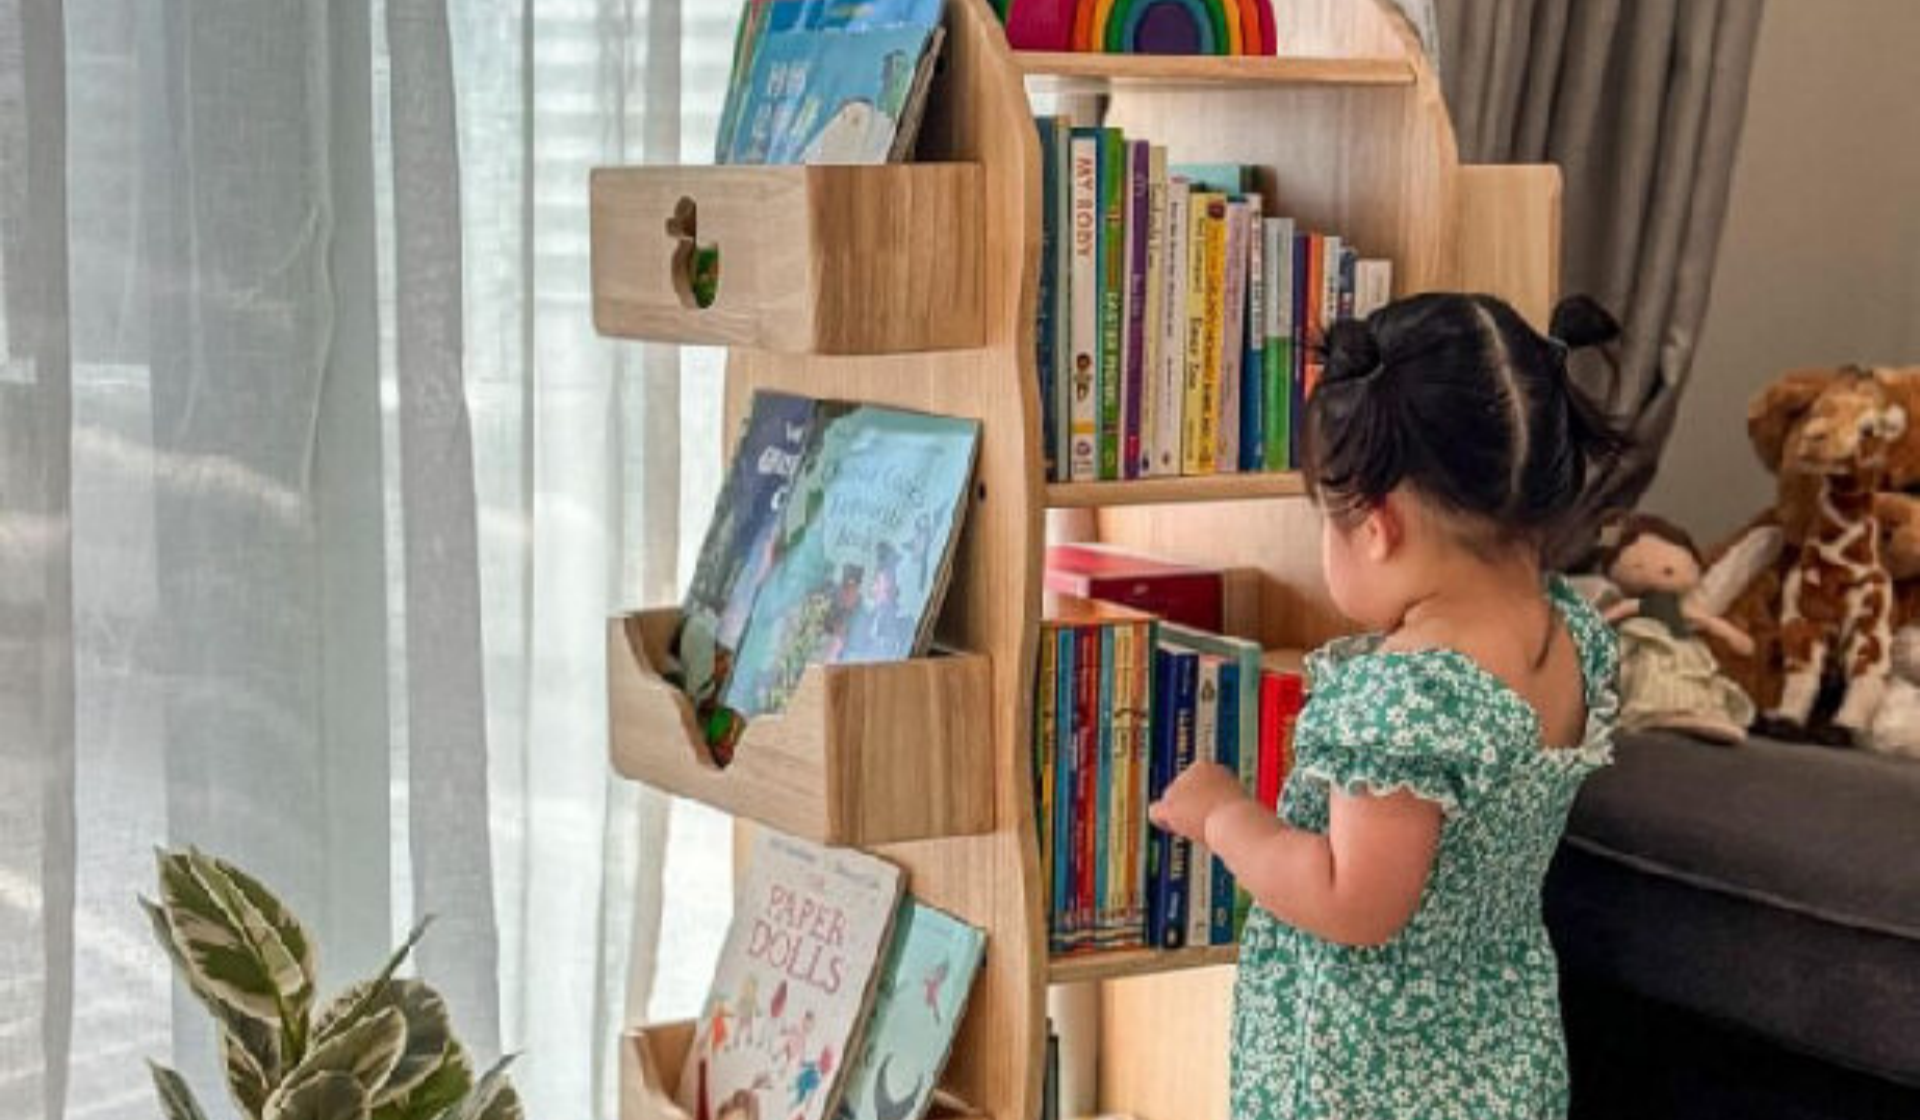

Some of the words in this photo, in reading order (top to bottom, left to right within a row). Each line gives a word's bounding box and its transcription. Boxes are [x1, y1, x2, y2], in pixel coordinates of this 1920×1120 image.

[1076, 157, 1094, 191] MY
[1076, 199, 1094, 257] BODY
[768, 884, 846, 946] PAPER
[748, 919, 844, 994] DOLLS
